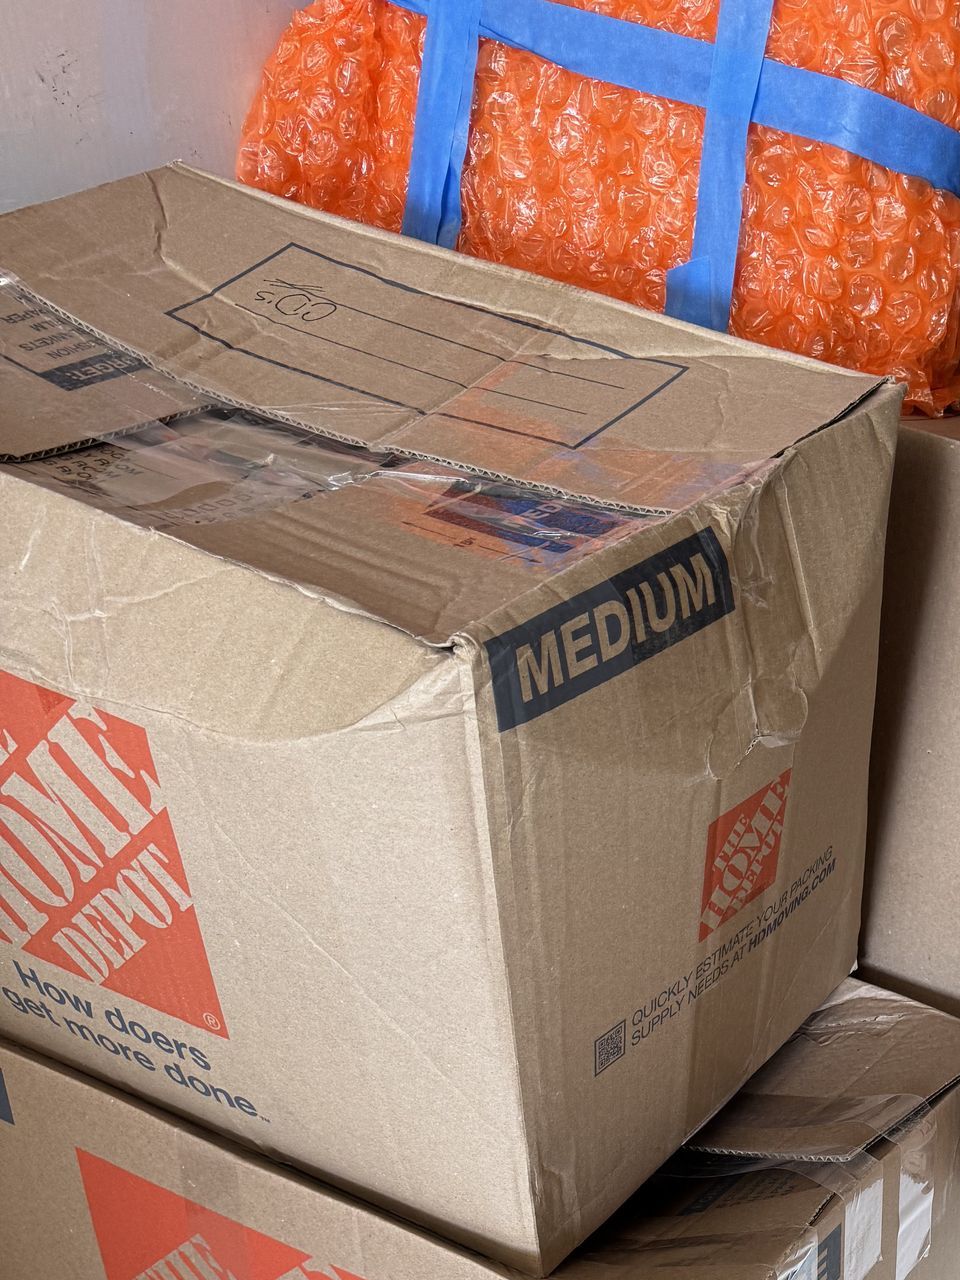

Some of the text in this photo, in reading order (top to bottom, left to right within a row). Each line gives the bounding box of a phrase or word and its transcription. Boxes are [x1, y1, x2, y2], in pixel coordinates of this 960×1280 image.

[515, 552, 717, 703] MEDIUM
[53, 843, 194, 984] DEPOT
[701, 776, 788, 929] HOME
[713, 814, 751, 872] THE
[631, 857, 837, 1047] SUPPLY NEEDS AT HDMOVING.COM
[632, 845, 834, 1027] QUICKLY ESTIMATE YOUR PACKING
[2, 985, 58, 1026] get
[62, 1014, 156, 1071] more
[12, 960, 211, 1071] How doers
